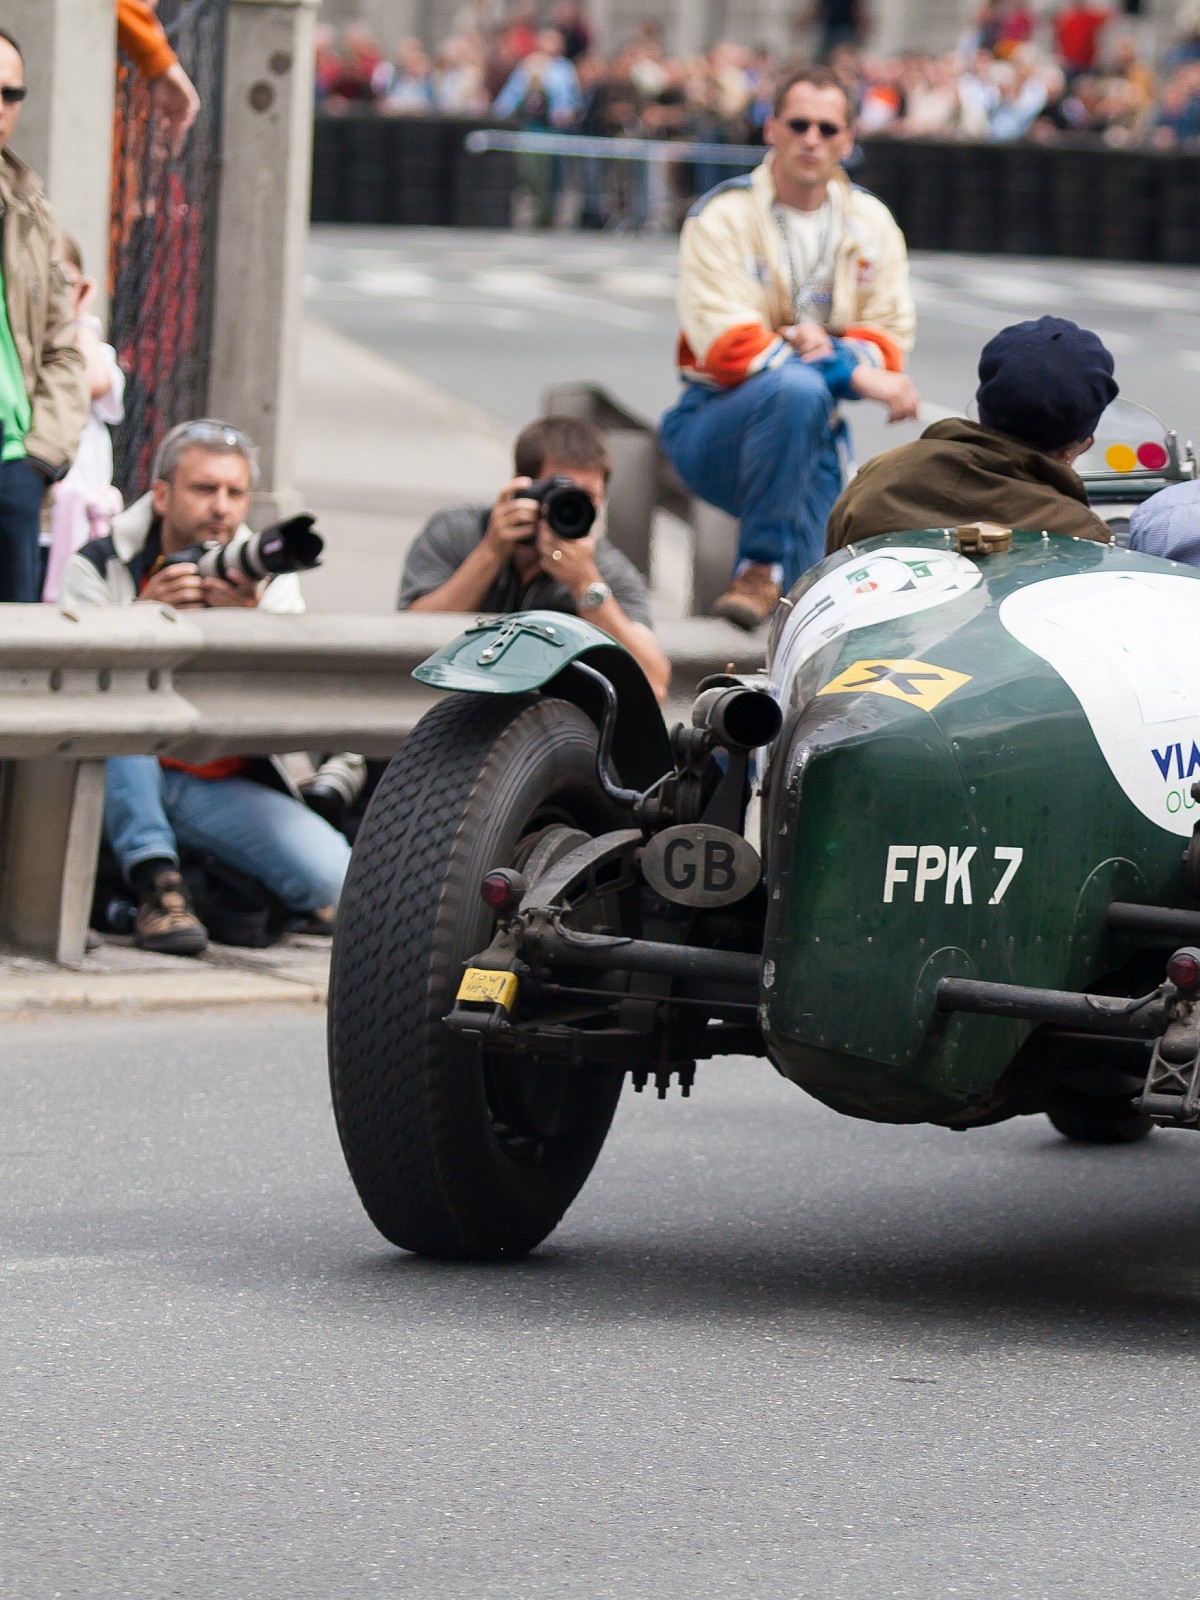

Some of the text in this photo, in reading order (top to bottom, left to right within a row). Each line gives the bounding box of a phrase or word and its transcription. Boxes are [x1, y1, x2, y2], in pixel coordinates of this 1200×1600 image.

[664, 838, 737, 892] GB
[883, 845, 1023, 904] FPK 7
[470, 972, 501, 983] TOW
